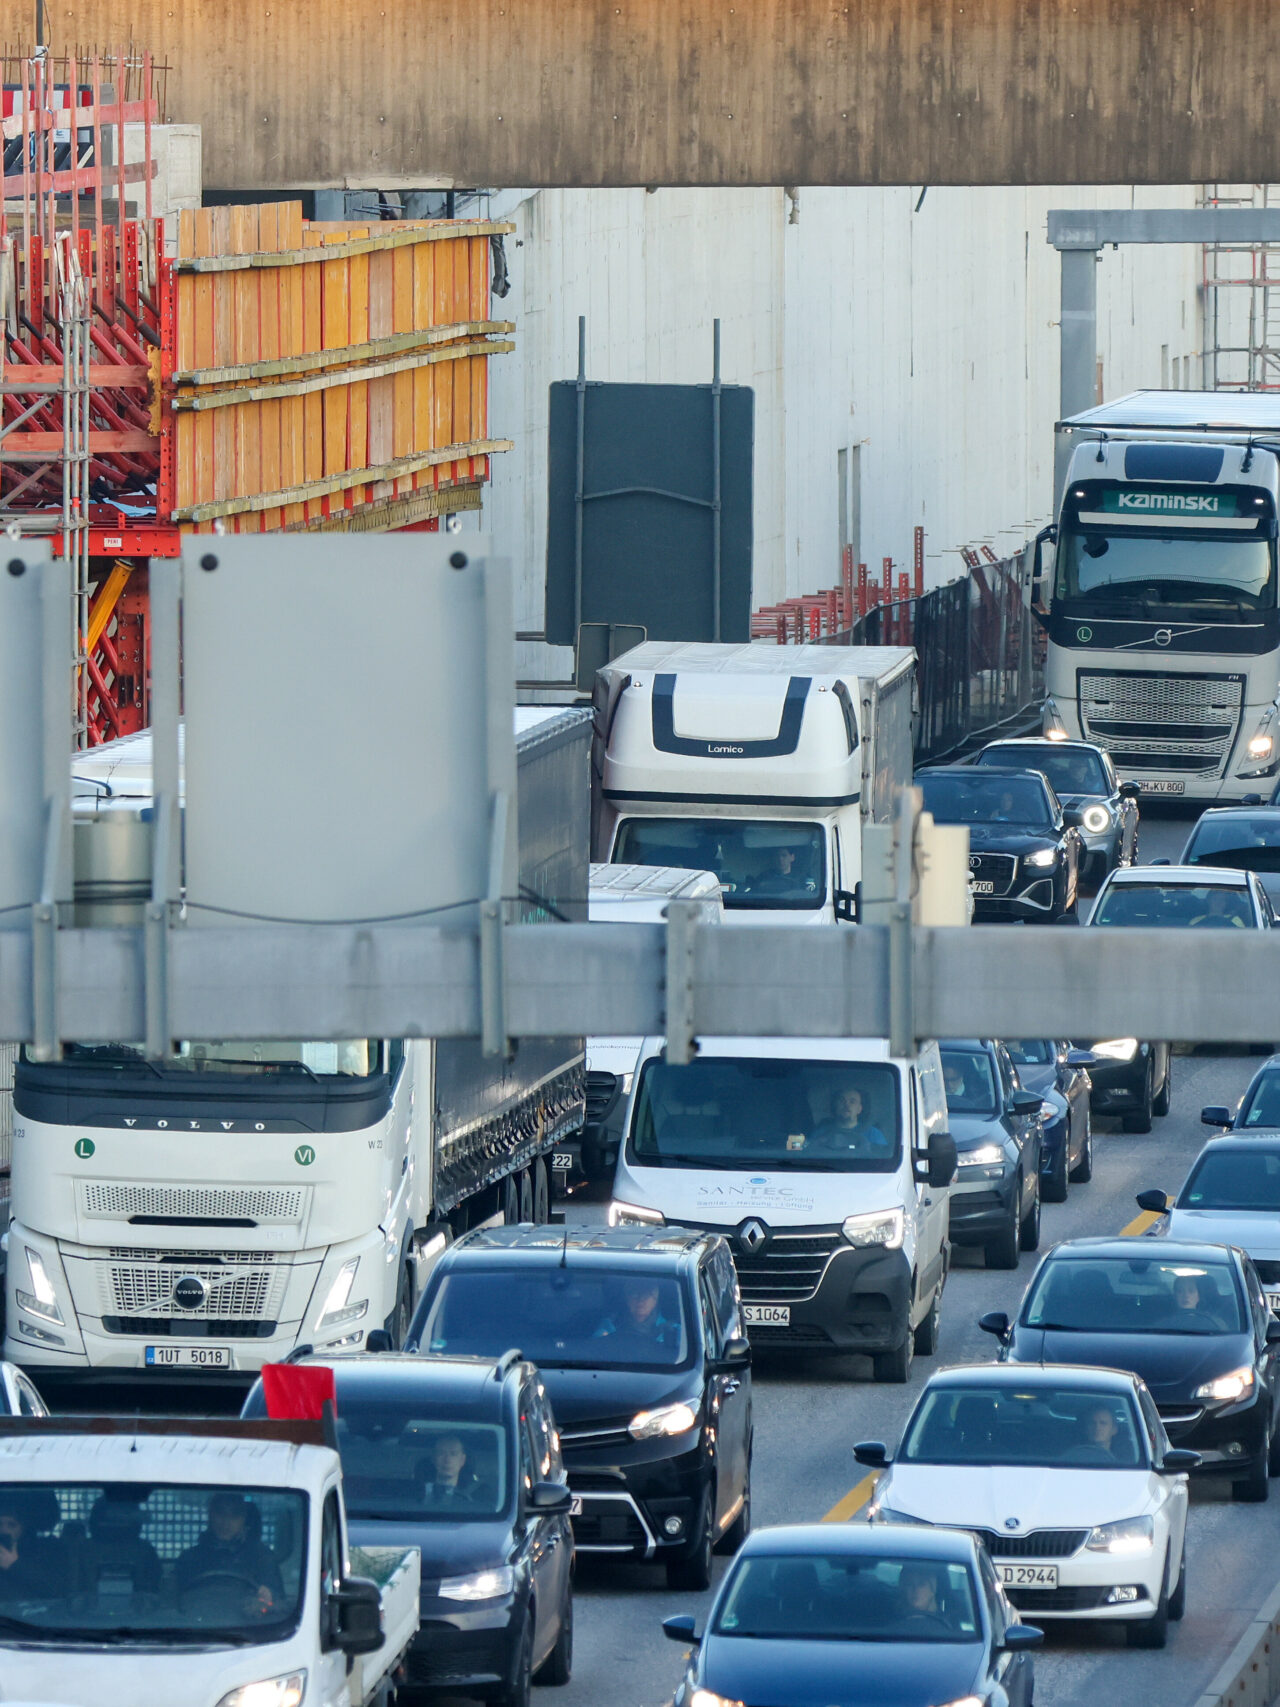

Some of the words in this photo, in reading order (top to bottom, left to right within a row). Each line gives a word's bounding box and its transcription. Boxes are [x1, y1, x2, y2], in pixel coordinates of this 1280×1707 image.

[708, 744, 744, 754] Lamico
[975, 882, 992, 891] 700
[123, 1118, 266, 1131] VOLVO
[298, 1149, 312, 1162] VI
[697, 1186, 794, 1196] SANTEC
[744, 1307, 753, 1321] S
[755, 1307, 789, 1322] 1064
[158, 1350, 181, 1363] 1UT
[191, 1350, 223, 1364] 5018
[1003, 1567, 1013, 1583] D
[1016, 1567, 1056, 1584] 2944
